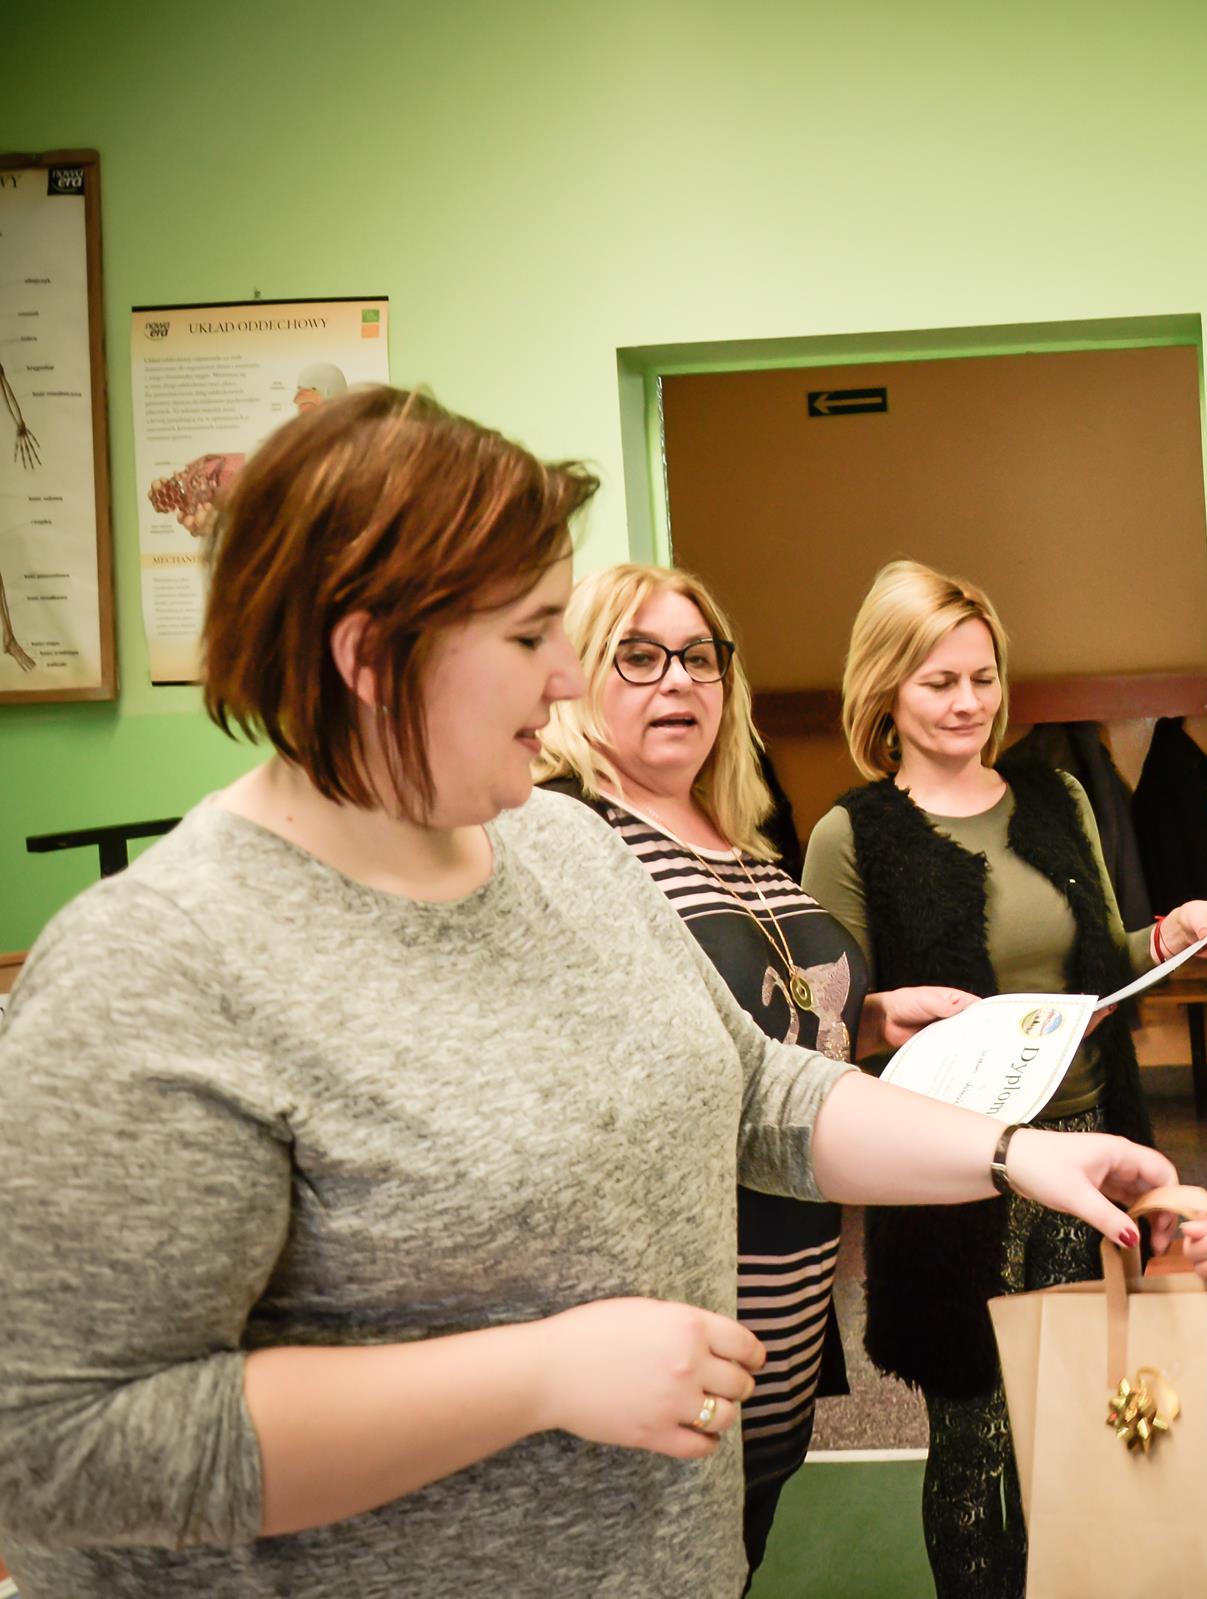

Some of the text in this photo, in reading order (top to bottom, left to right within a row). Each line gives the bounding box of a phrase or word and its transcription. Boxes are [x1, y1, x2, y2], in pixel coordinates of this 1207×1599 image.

[188, 317, 328, 334] UKŁAD ODDECHOWY
[986, 1047, 1040, 1115] Dyplom
